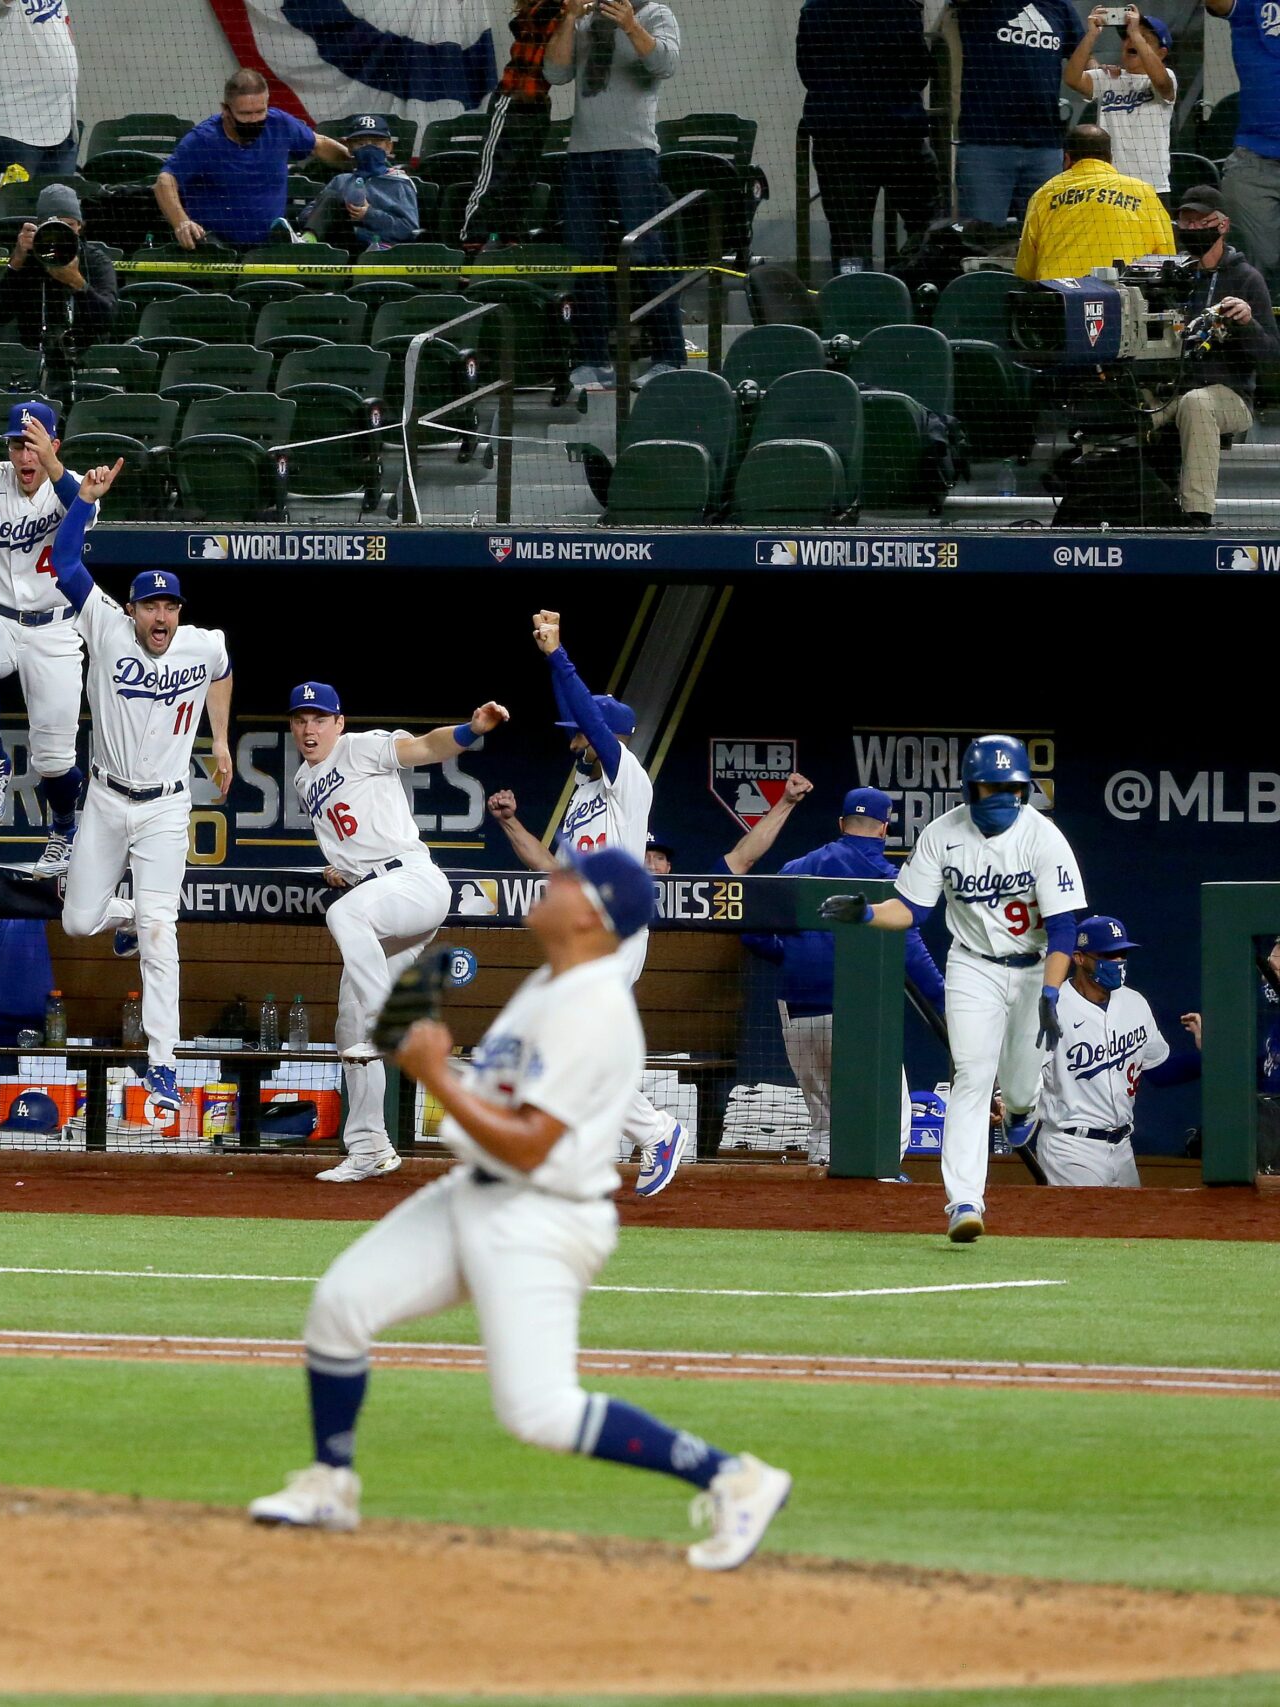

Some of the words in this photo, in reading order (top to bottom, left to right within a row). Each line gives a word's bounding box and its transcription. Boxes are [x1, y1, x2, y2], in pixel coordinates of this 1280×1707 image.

[997, 24, 1061, 50] addas
[359, 116, 376, 129] TB
[1050, 188, 1094, 210] EVENT
[1096, 188, 1142, 211] STAFF
[230, 535, 300, 560] WORLD
[302, 535, 365, 561] SERIES
[366, 536, 386, 548] 20
[490, 538, 511, 547] MLB
[516, 541, 555, 560] MLB
[558, 541, 653, 561] NETWORK
[937, 543, 958, 555] 20
[366, 548, 386, 561] 20
[799, 541, 868, 567] WORLD
[871, 542, 936, 568] SERIES
[937, 555, 958, 568] 20
[1053, 547, 1123, 567] @MLB
[154, 573, 167, 588] LA
[113, 657, 207, 706] Dodgers
[303, 684, 315, 700] LA
[173, 700, 196, 736] 11
[715, 743, 792, 771] MLB
[995, 749, 1011, 769] LA
[715, 770, 791, 781] NETWORK
[1104, 769, 1280, 823] @MLB
[326, 800, 360, 843] 16
[942, 864, 1036, 908] Dodgers
[1056, 865, 1074, 893] LA
[177, 882, 330, 914] NETWORK
[712, 882, 743, 901] 20
[712, 900, 743, 920] 20
[1109, 922, 1123, 938] LA
[1066, 1024, 1148, 1079] Dodgers
[17, 1100, 29, 1117] LA
